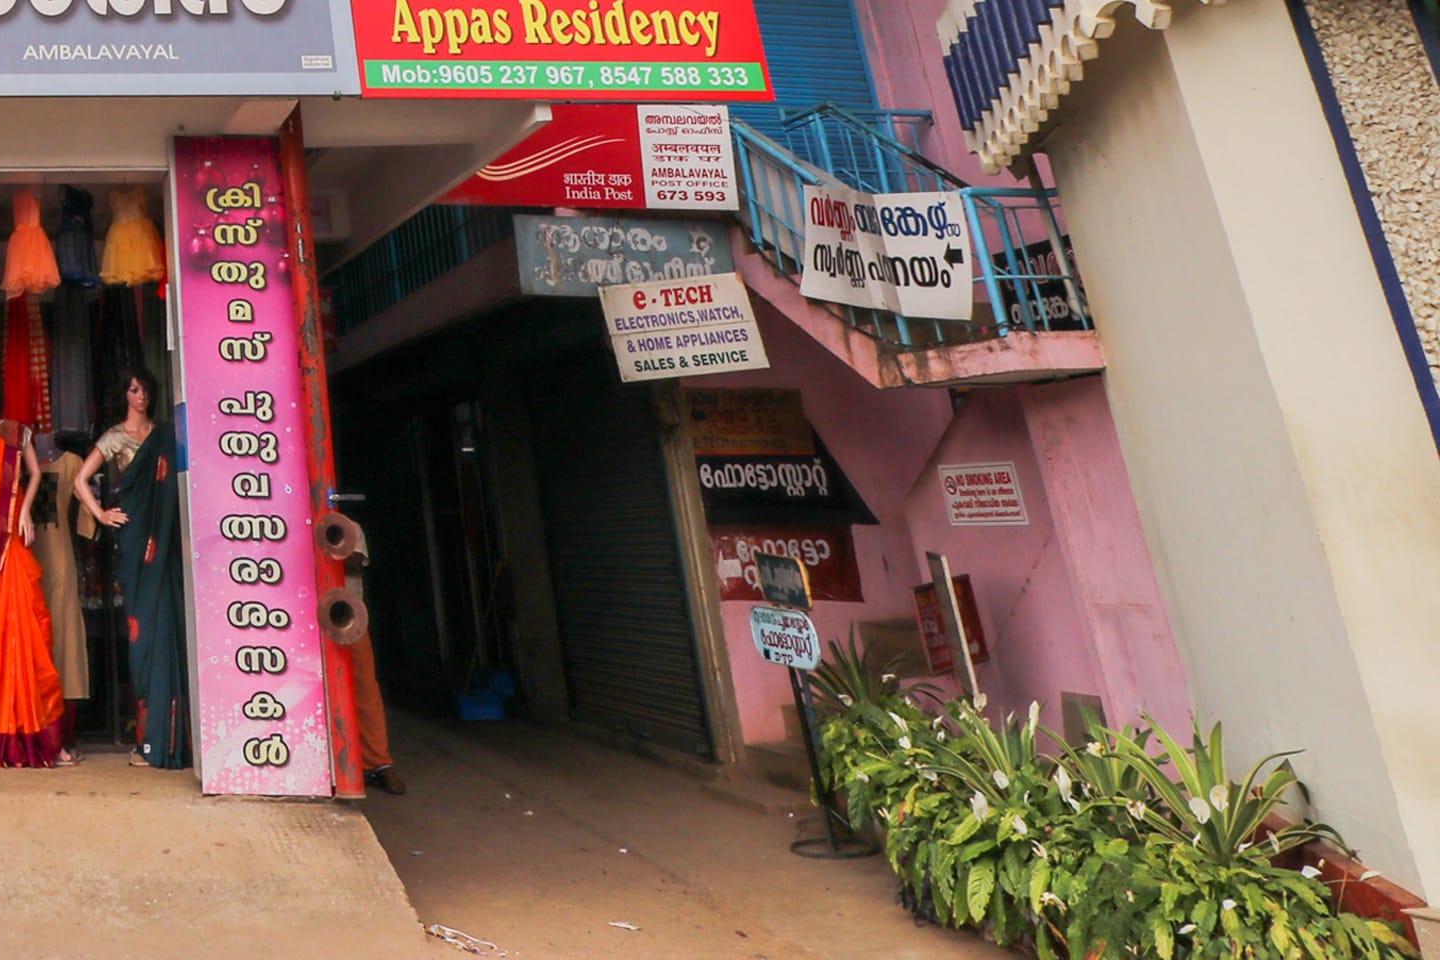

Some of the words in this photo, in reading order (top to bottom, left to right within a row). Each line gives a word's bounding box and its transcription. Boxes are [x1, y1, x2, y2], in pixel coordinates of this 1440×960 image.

[23, 43, 179, 61] AMBALAVAYAL
[381, 64, 493, 86] Mob:9605
[499, 65, 537, 86] 237
[546, 66, 595, 89] 967,
[600, 66, 652, 86] 8547
[661, 67, 701, 87] 588
[707, 67, 749, 87] 333
[563, 170, 605, 186] भारतीय
[608, 173, 633, 187] डाक
[651, 167, 728, 179] AMBALAVAYAL
[651, 180, 683, 188] POST
[686, 180, 729, 188] OFFICE
[565, 186, 602, 200] India
[605, 188, 633, 201] Post
[657, 190, 689, 201] 673
[694, 191, 727, 202] 593
[626, 340, 638, 354] &
[639, 336, 673, 352] HOME
[676, 328, 750, 349] APPLIANCES
[634, 357, 676, 373] SALES
[679, 355, 689, 368] &
[693, 349, 750, 367] SERVICE
[965, 472, 994, 486] SMOKING
[994, 471, 1012, 484] AREA
